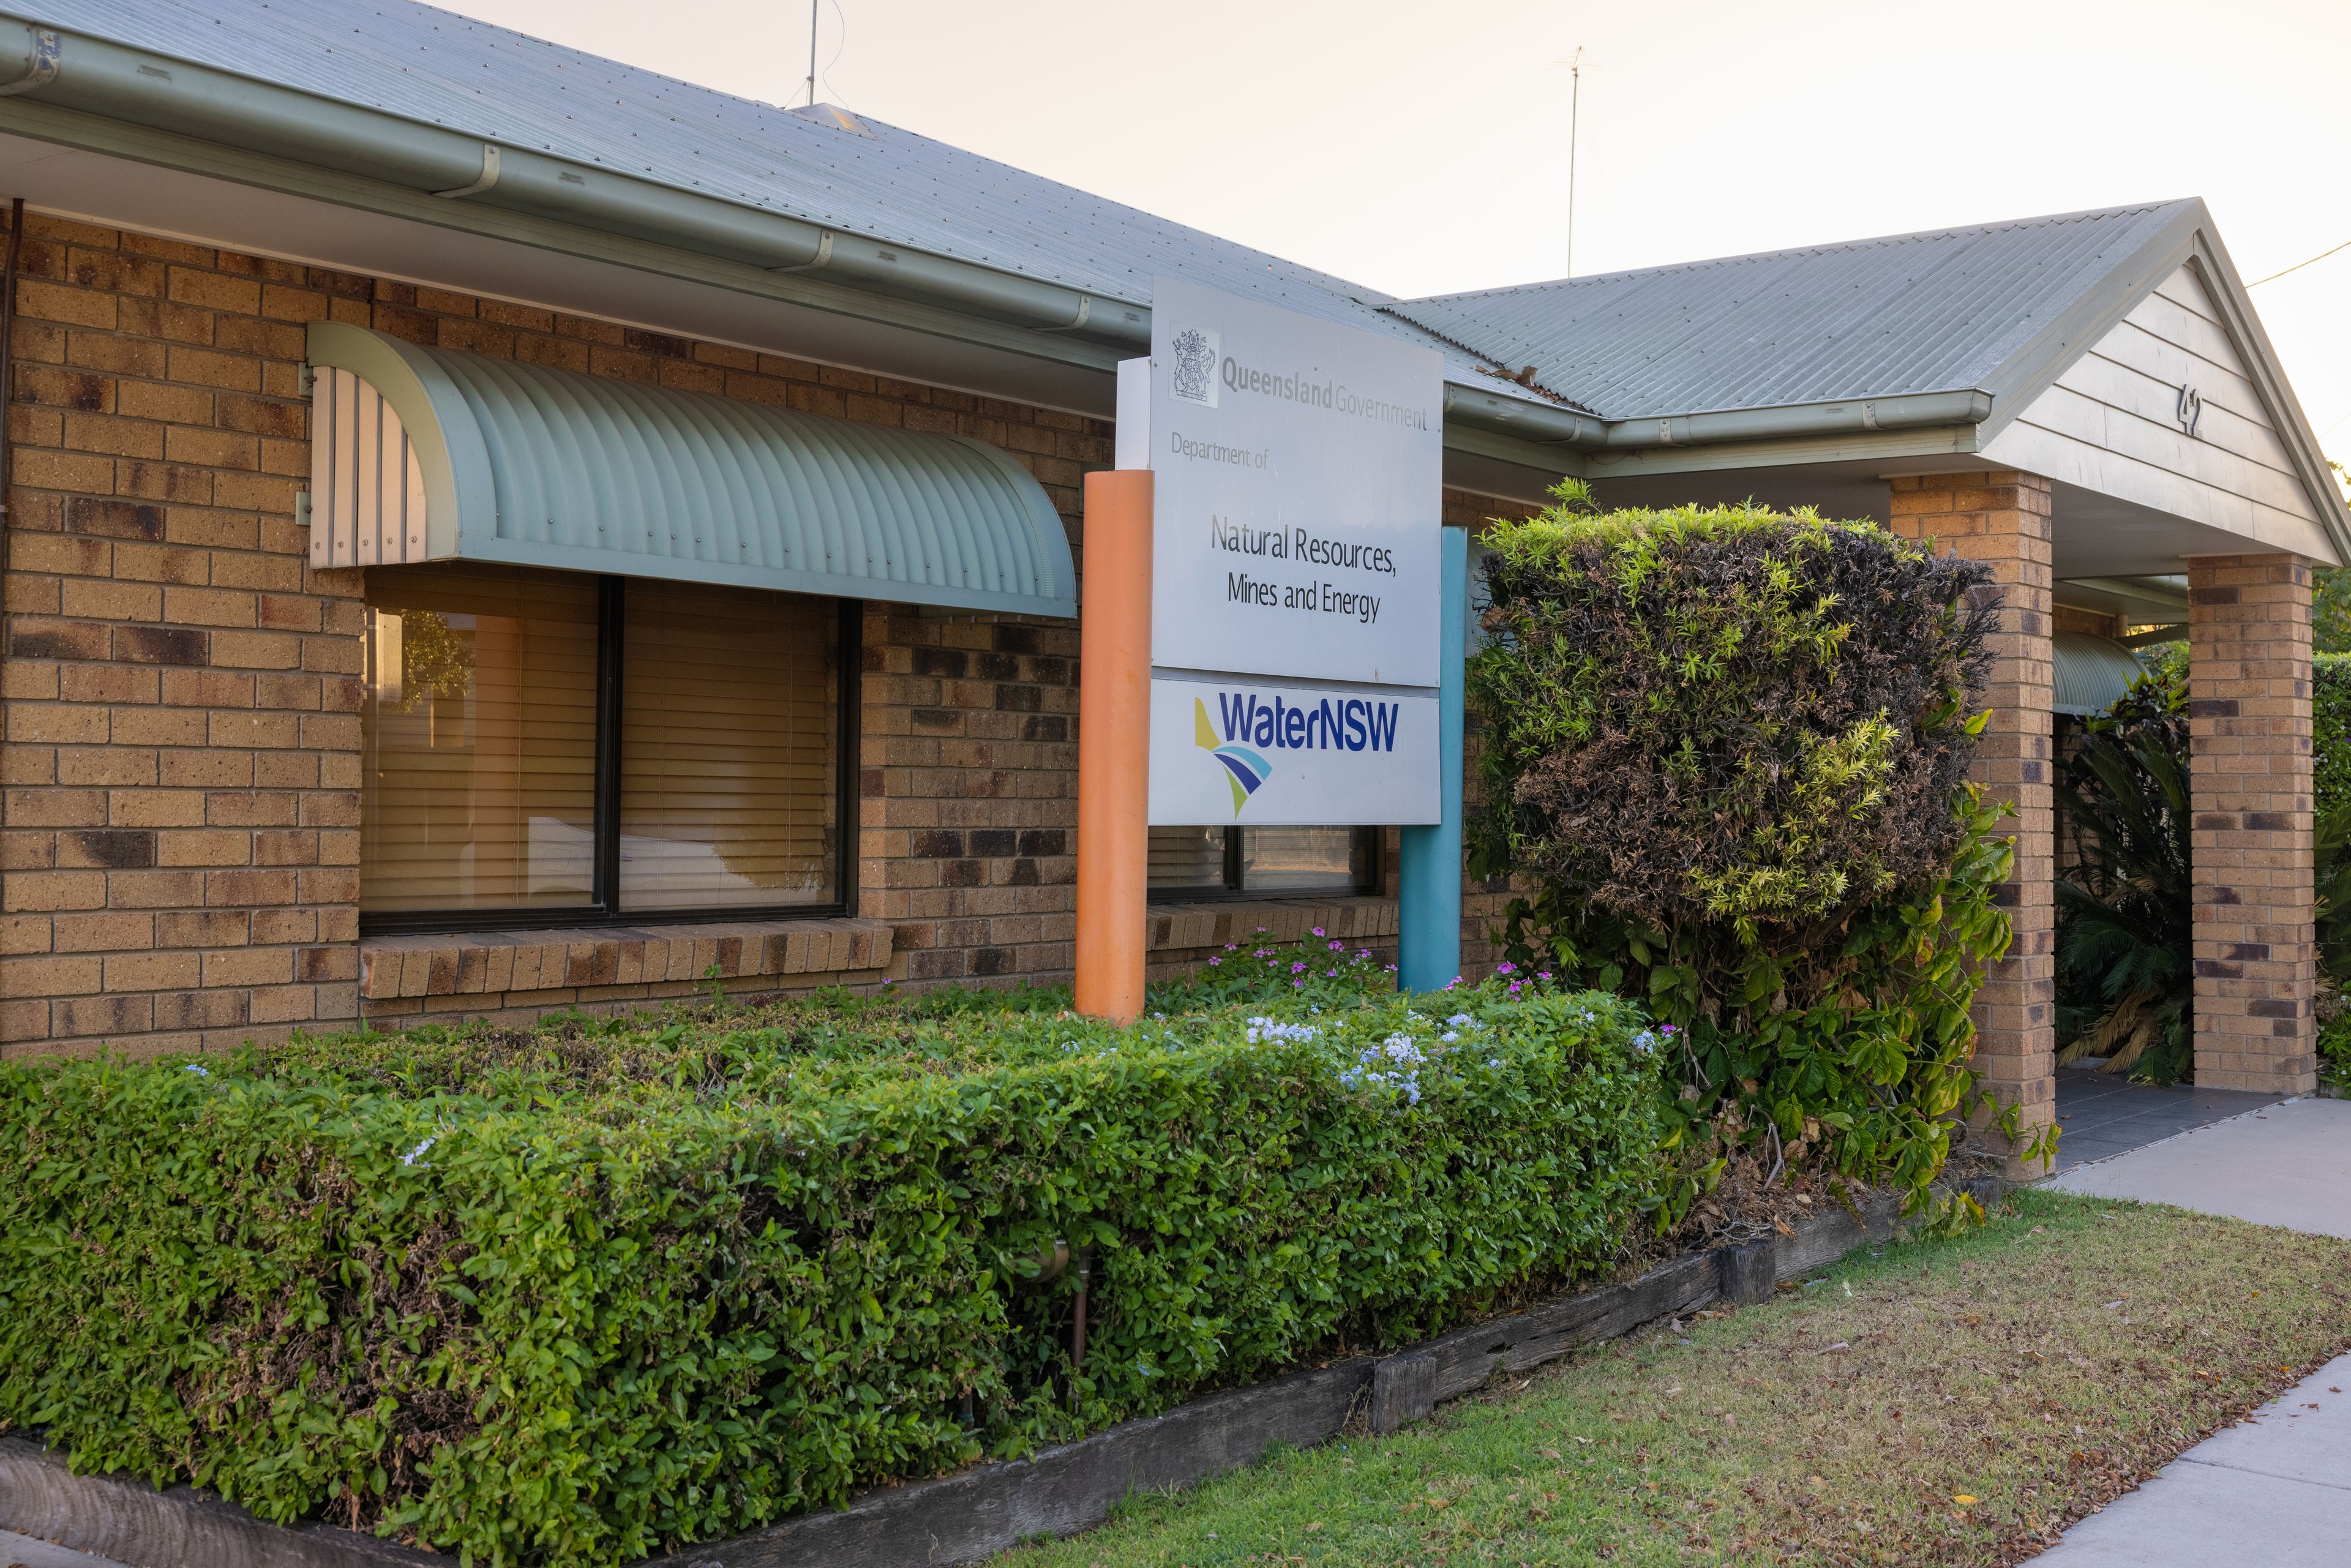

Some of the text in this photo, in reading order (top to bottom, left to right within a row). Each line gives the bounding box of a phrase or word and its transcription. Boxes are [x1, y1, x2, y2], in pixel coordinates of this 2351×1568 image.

[1222, 356, 1428, 431] Queensland Government
[2177, 383, 2203, 439] 42
[1171, 432, 1270, 470] Department of
[1212, 514, 1397, 577] Natural Resources,
[1228, 572, 1381, 624] Mines and Energy
[1219, 692, 1399, 752] WaterNSW
